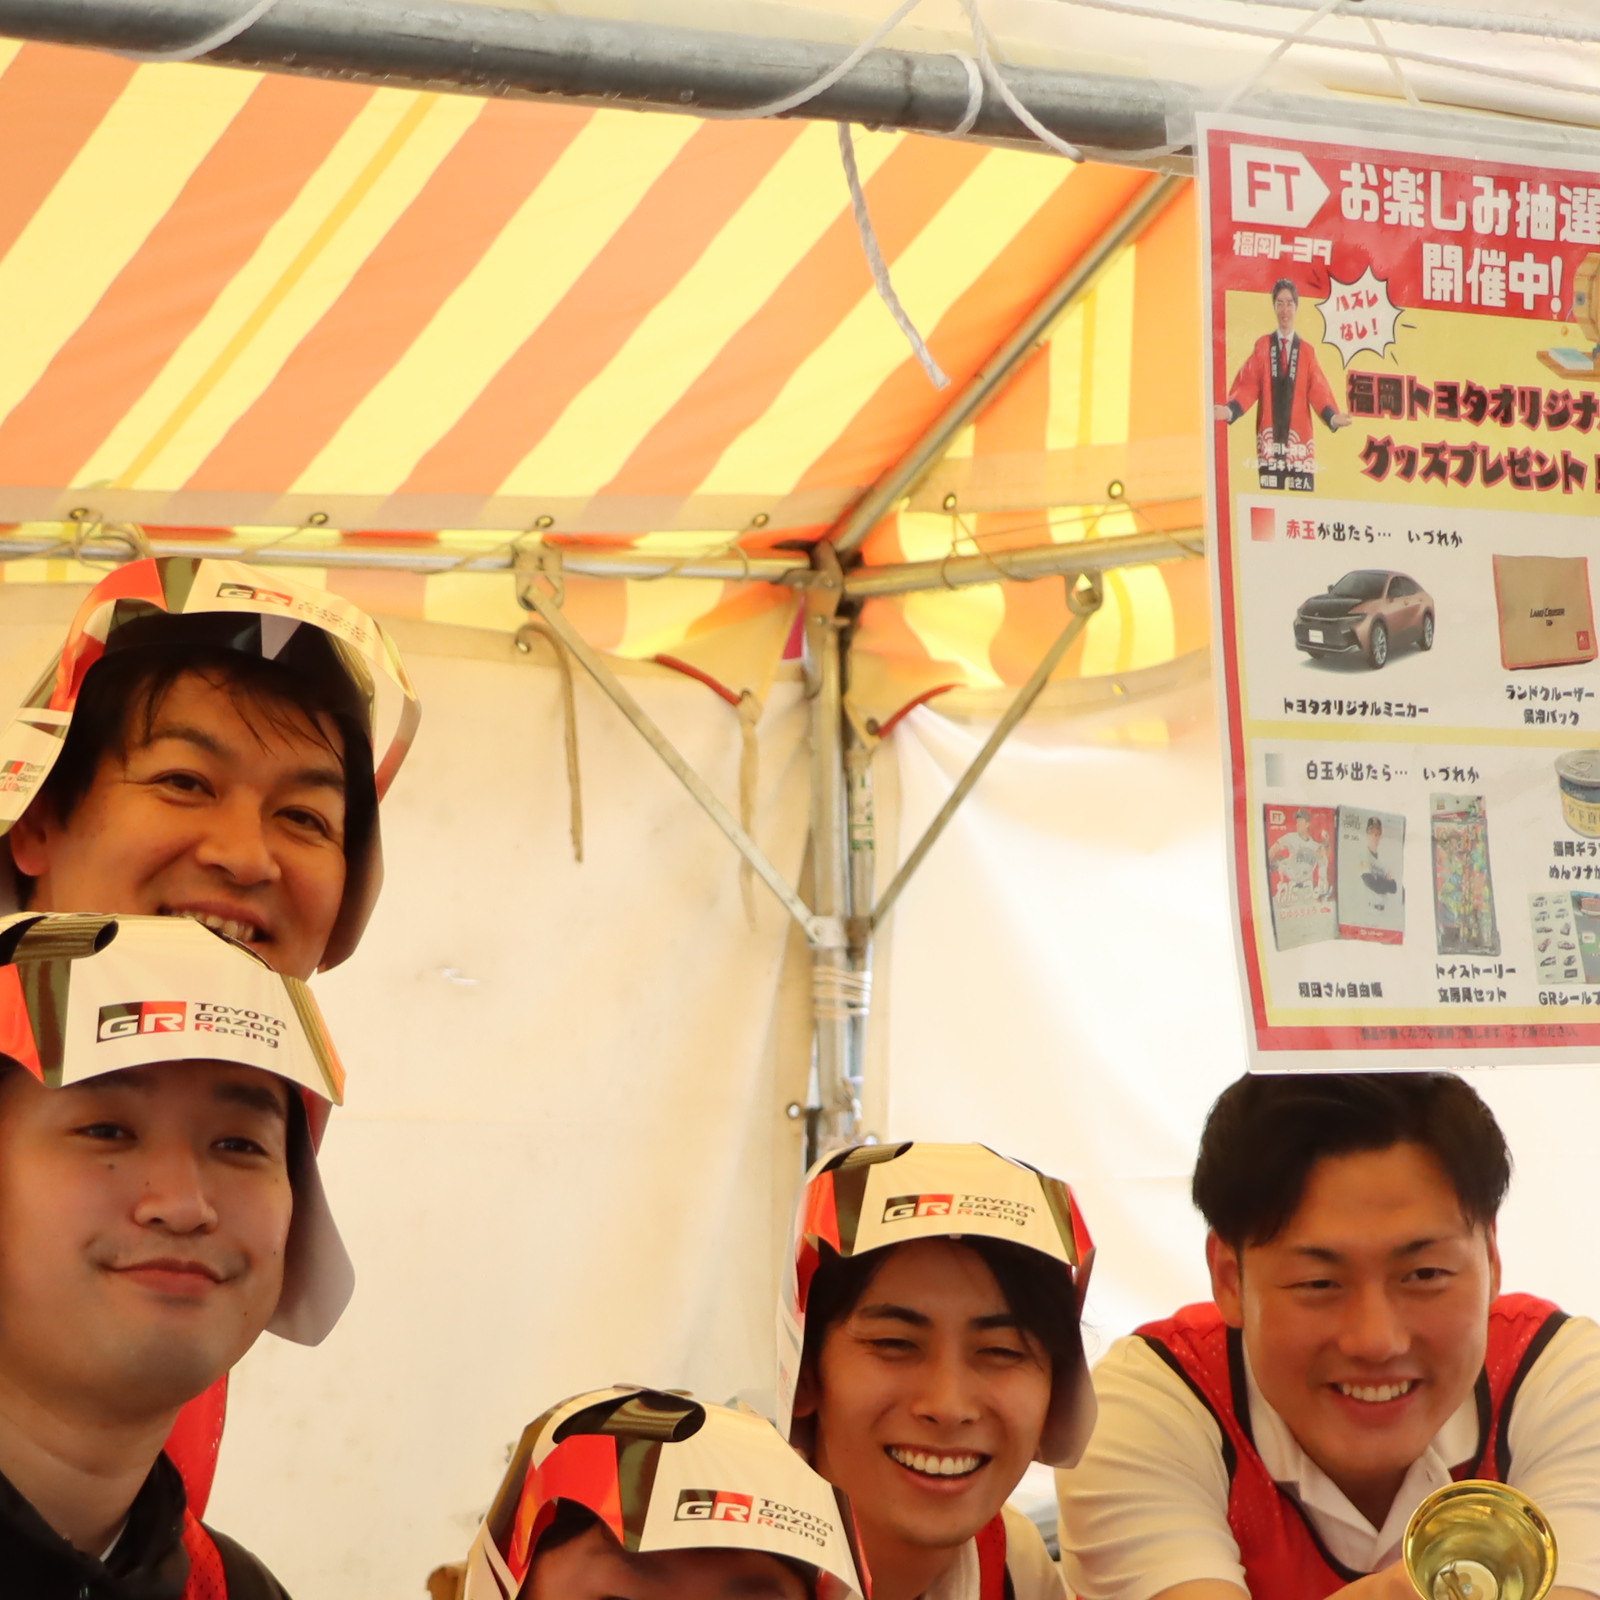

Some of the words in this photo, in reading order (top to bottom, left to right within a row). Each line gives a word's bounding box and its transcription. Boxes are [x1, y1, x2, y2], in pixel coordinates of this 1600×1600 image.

[1247, 160, 1302, 214] FT
[1232, 230, 1333, 265] 福岡トヨタ
[1421, 242, 1564, 316] 開催中!
[1335, 289, 1379, 314] ハズレ
[1338, 318, 1379, 343] なし!
[1408, 529, 1463, 549] いづれか
[1505, 684, 1595, 702] ランドクルーザー
[1284, 697, 1429, 719] トヨタオリジナルミニカー
[1422, 765, 1480, 784] いづれか
[1435, 964, 1517, 980] トイストーリー
[1437, 986, 1508, 1003] 文房具セット
[98, 1007, 186, 1042] GR
[194, 1002, 287, 1030] TOYOTA
[194, 1012, 281, 1037] GAZOO
[194, 1022, 279, 1049] Racing
[882, 1197, 952, 1223] GR
[958, 1201, 1029, 1218] GAZOO
[960, 1193, 1036, 1213] TOYOTA
[956, 1208, 1026, 1227] Racing
[675, 1494, 752, 1523] GR
[759, 1497, 834, 1532] TOYOTA
[756, 1516, 826, 1548] Racing
[758, 1507, 828, 1538] GAZOO
